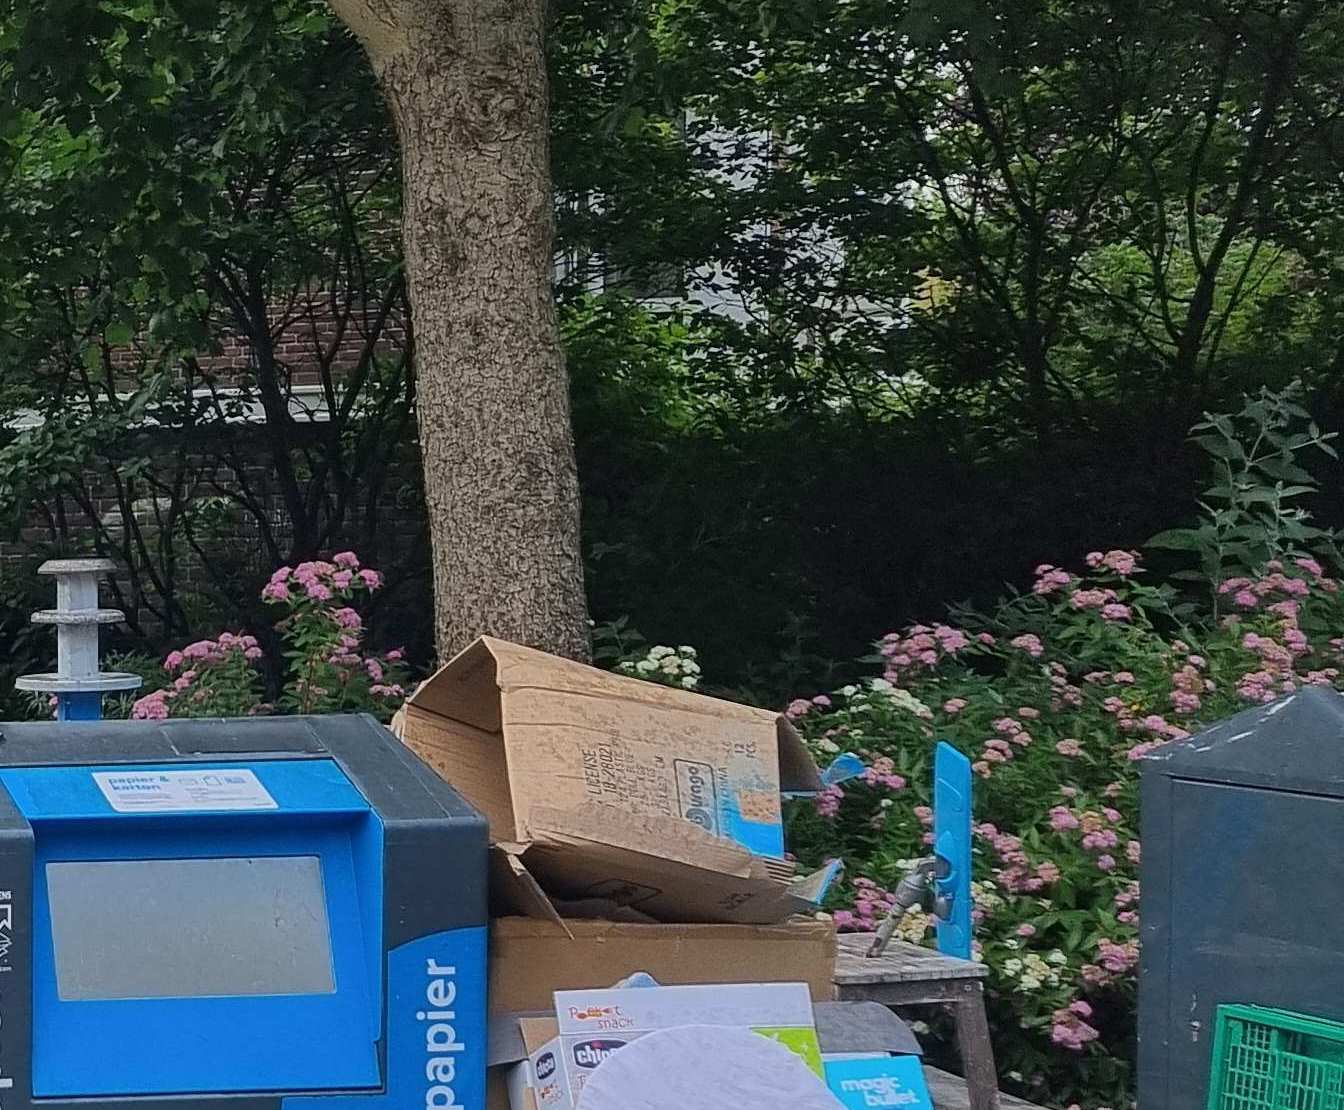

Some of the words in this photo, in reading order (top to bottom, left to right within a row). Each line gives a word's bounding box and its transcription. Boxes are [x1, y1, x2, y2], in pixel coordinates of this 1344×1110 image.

[583, 748, 602, 796] LICENSE
[576, 1045, 618, 1065] chic
[840, 1073, 901, 1094] magic
[863, 1089, 921, 1107] bullet
